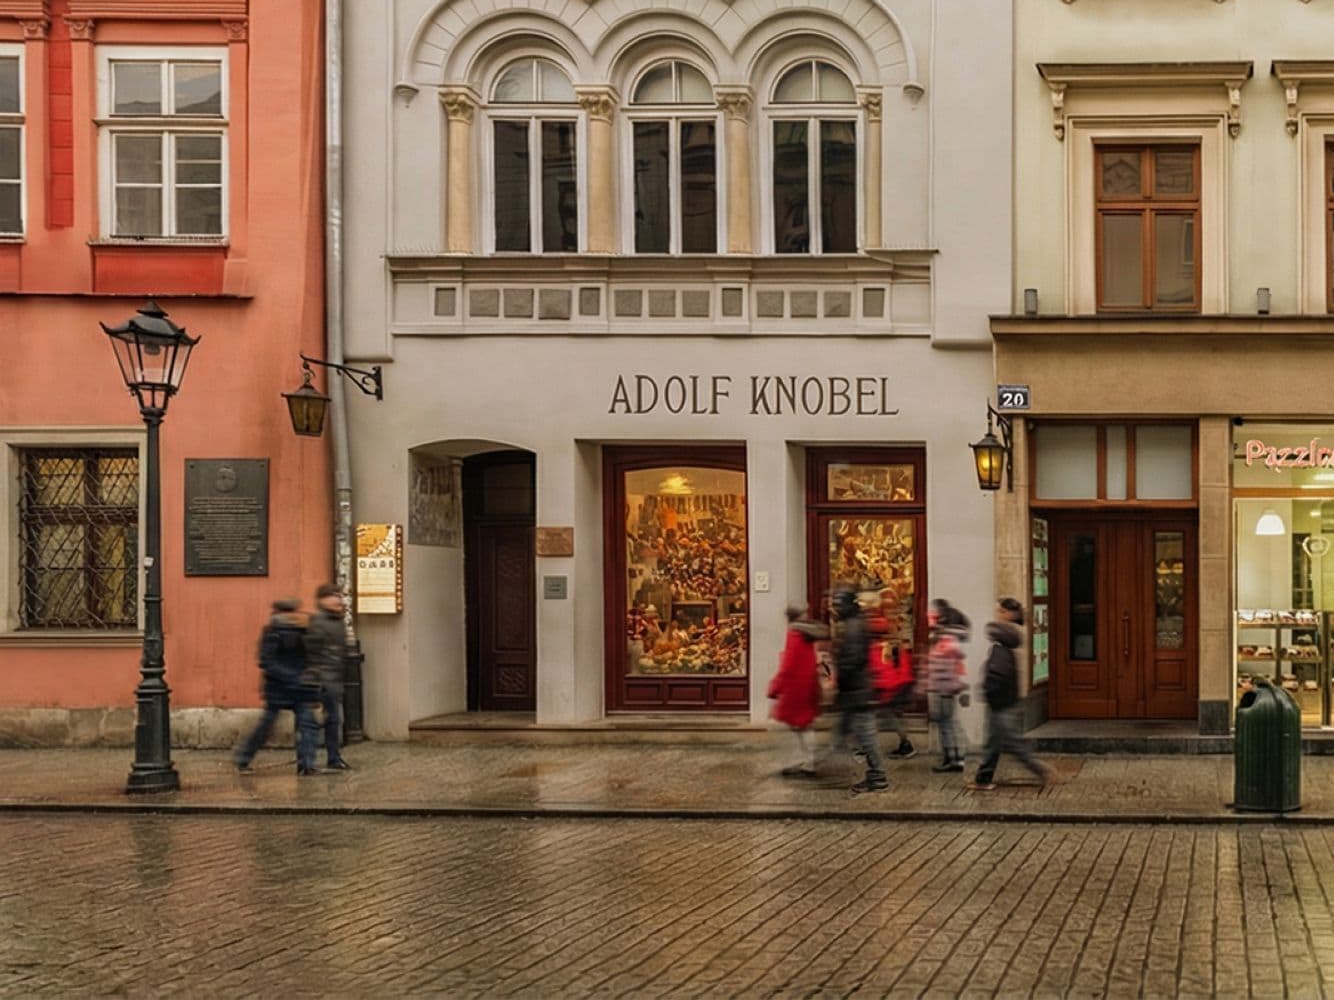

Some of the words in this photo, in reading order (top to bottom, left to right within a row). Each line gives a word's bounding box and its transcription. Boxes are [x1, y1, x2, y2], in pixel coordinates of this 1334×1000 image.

[608, 374, 732, 415] ADOLF
[749, 375, 900, 416] KNOBEL
[1002, 392, 1025, 408] 20
